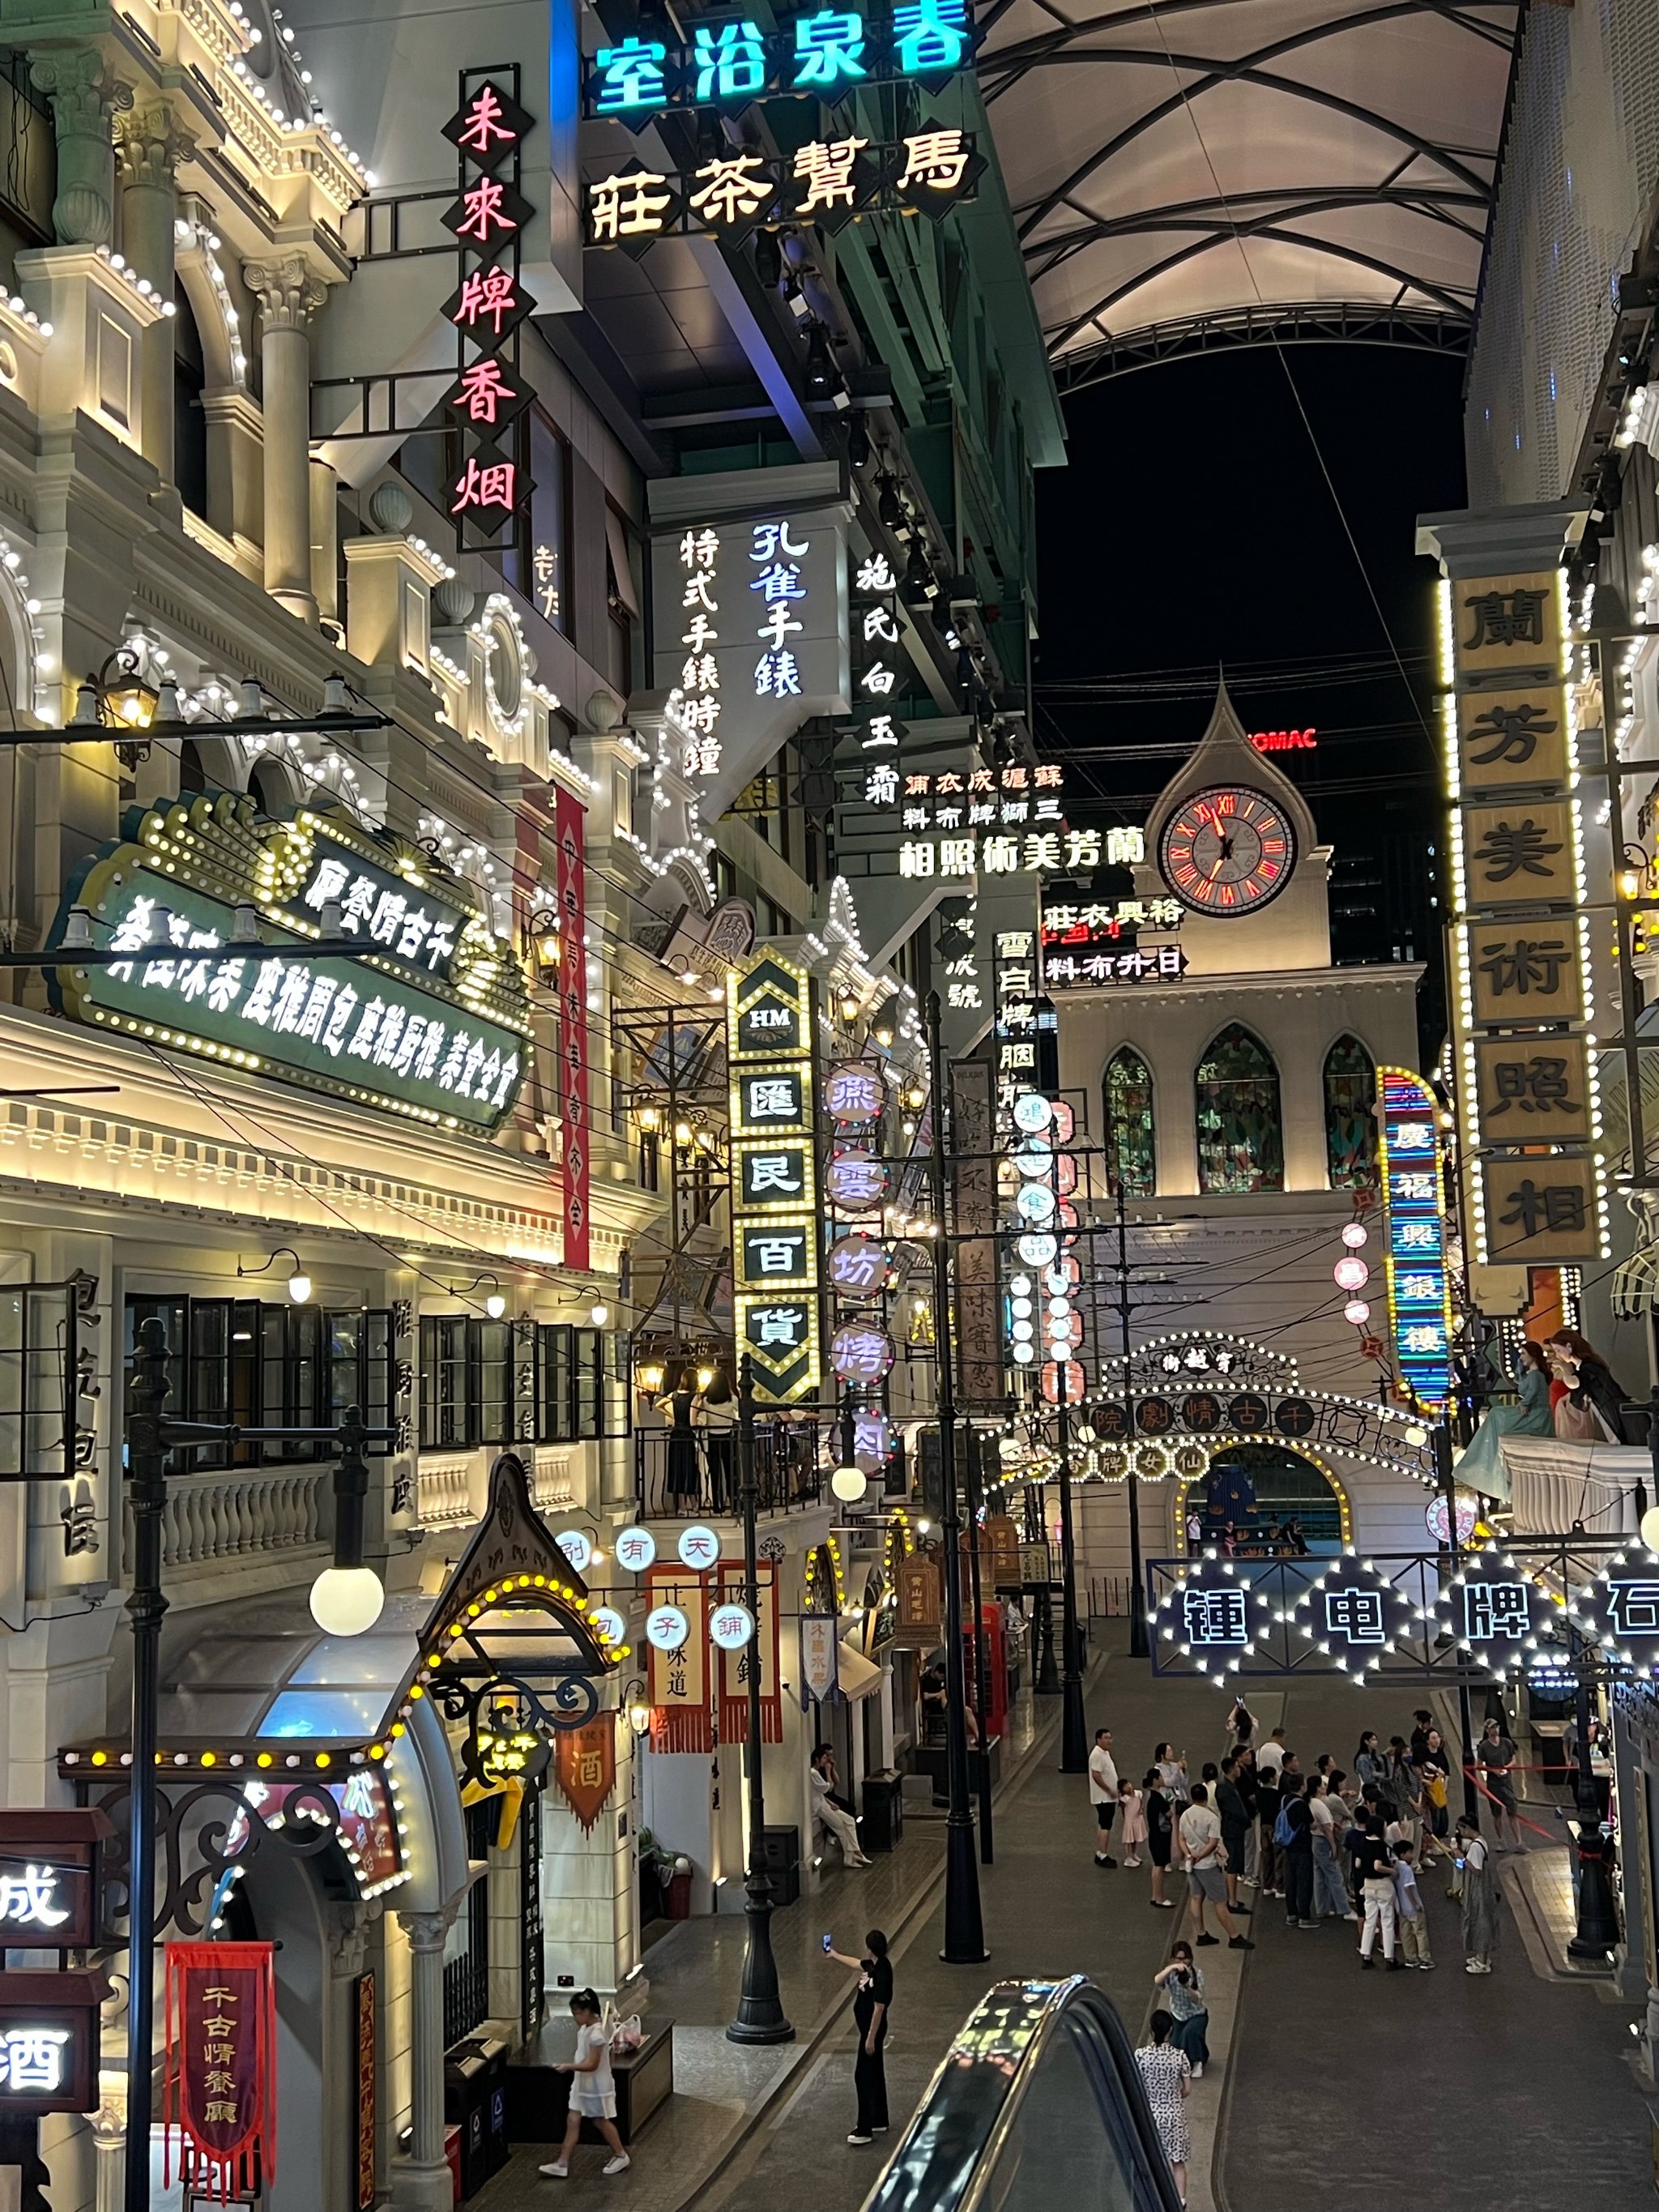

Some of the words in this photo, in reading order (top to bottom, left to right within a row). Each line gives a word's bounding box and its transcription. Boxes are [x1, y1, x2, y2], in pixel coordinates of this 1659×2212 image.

[748, 521, 809, 698] 孔雀手錶
[855, 552, 900, 805] 施氏白玉霜
[1247, 728, 1318, 752] OMAC
[899, 826, 1145, 878] 蘭芳美術照相
[1045, 951, 1181, 981] 日升布料
[1463, 587, 1585, 1237] 蘭芳美術照相
[749, 1008, 791, 1028] HM
[748, 1079, 803, 1347] 匯民百貨
[666, 1582, 688, 1697] 上味道
[570, 1750, 603, 1788] 酒
[203, 1986, 238, 2124] 千古情餐廳
